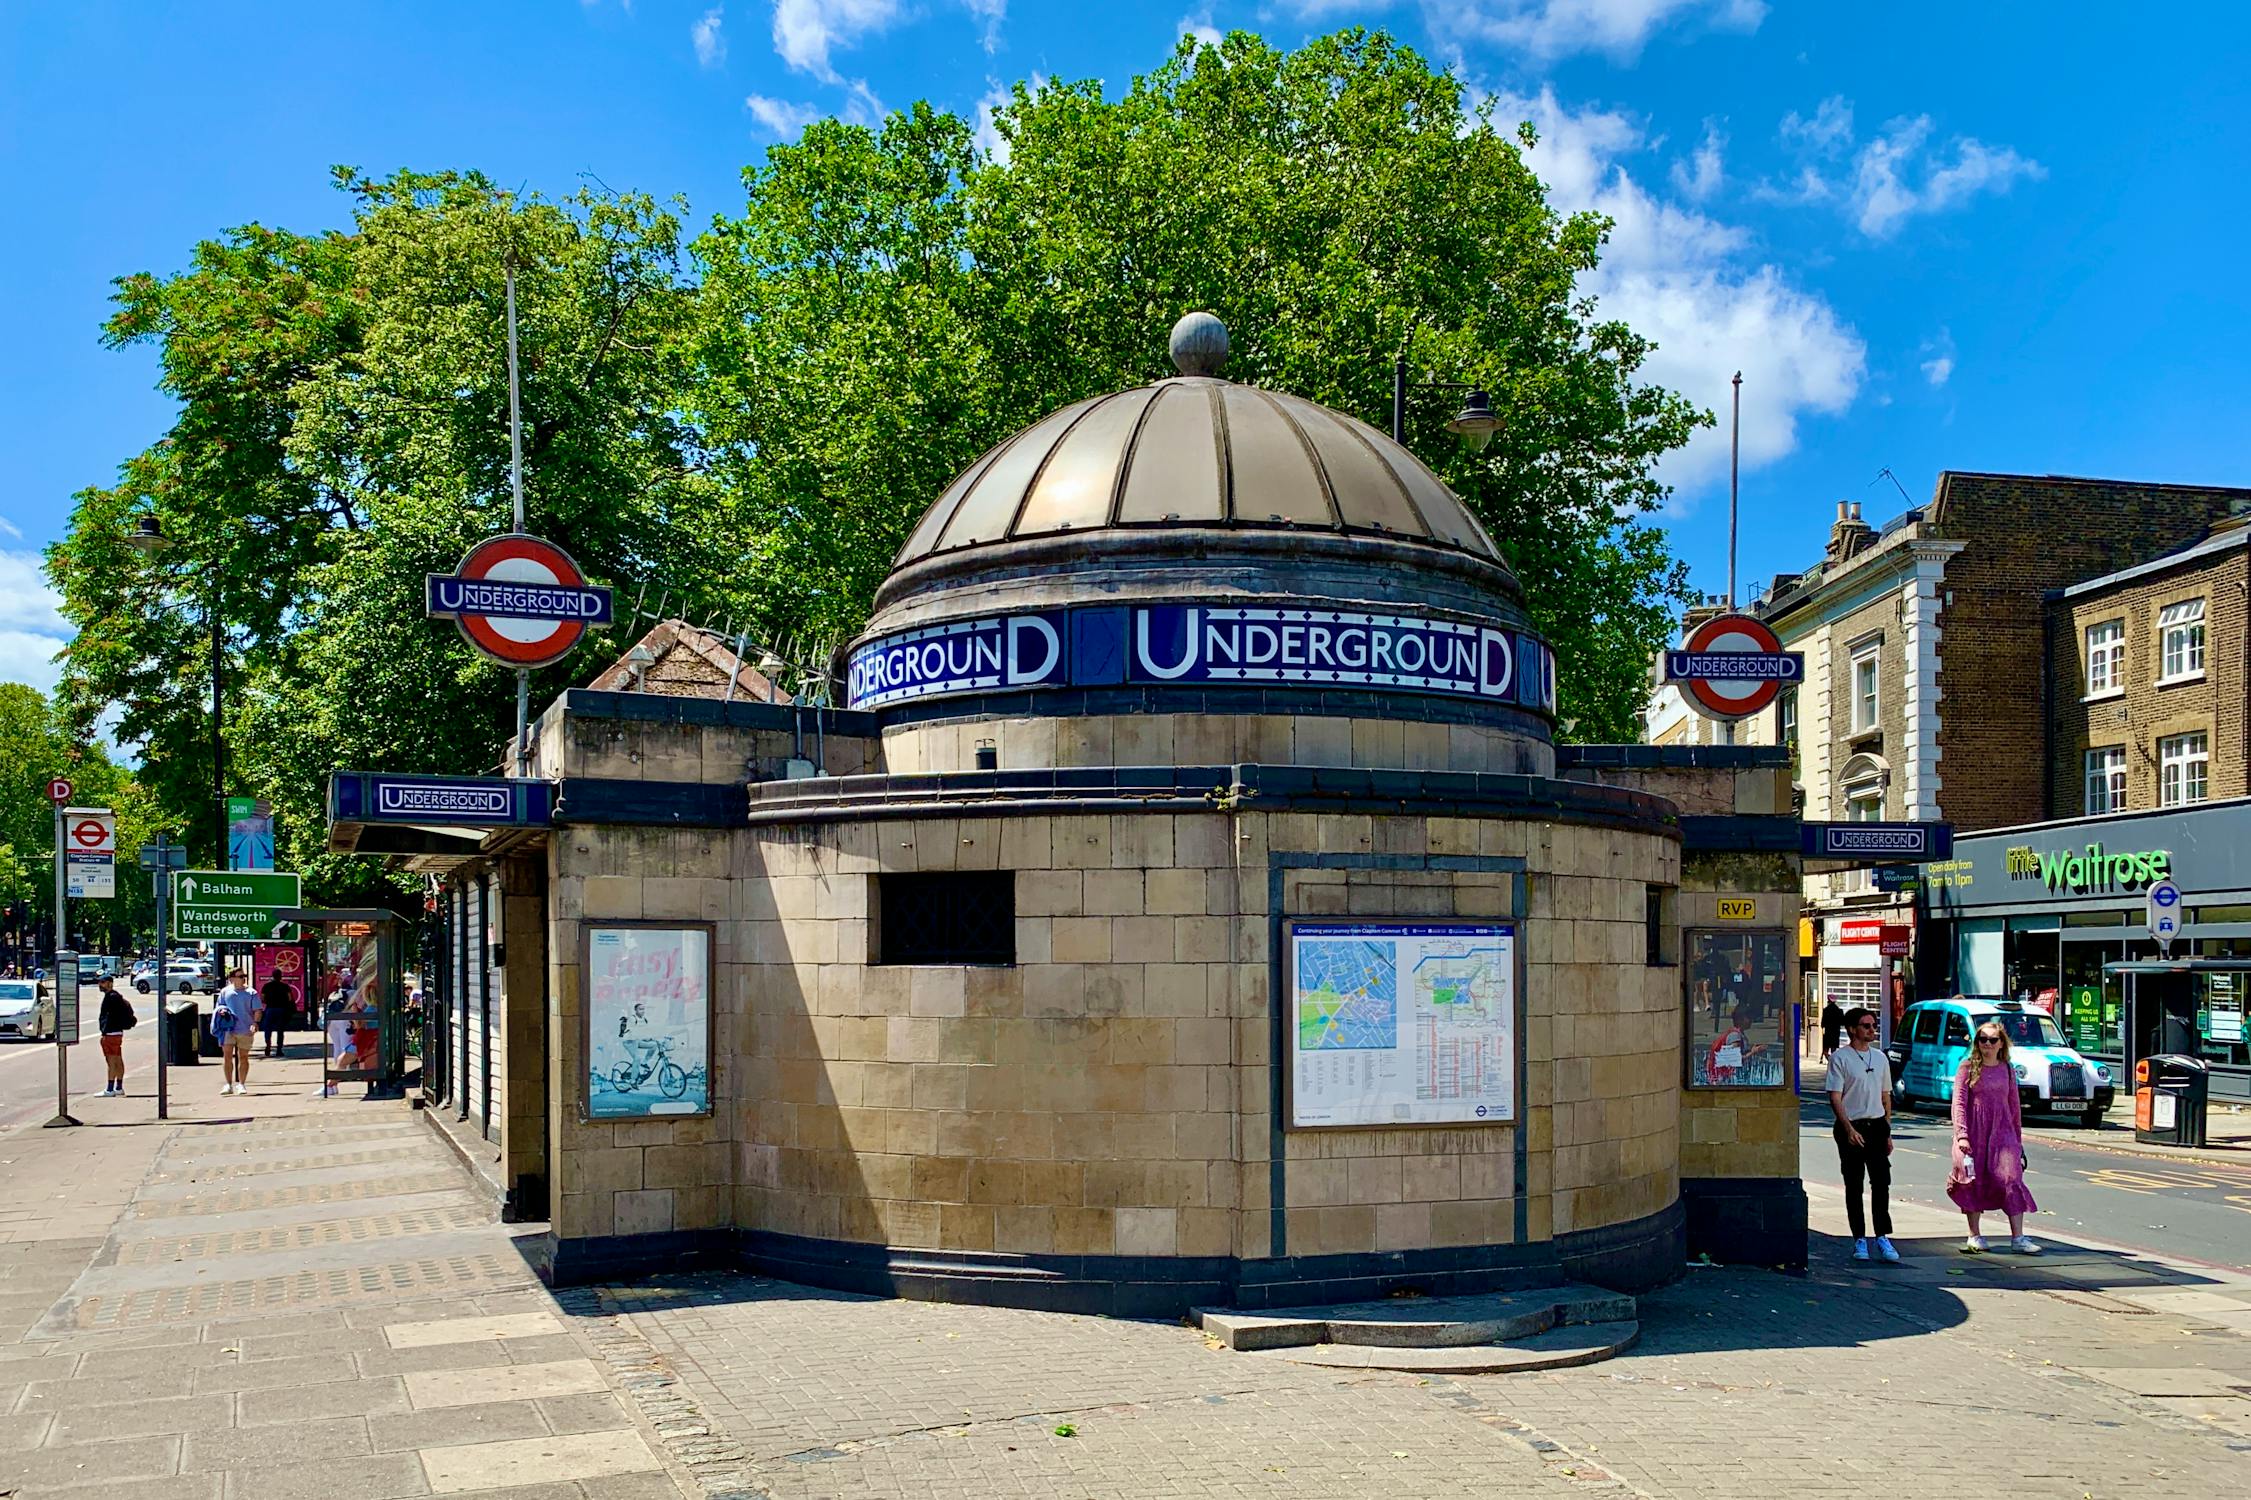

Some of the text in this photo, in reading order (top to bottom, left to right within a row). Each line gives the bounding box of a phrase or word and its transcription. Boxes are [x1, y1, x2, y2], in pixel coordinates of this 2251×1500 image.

[440, 583, 602, 617] UNDERGROUND
[1138, 608, 1513, 697] UNDERGROUND
[1673, 656, 1797, 677] UNDERGROUND
[54, 782, 70, 799] D
[385, 788, 505, 811] UNDERGROUND
[231, 805, 248, 814] SWIM
[1832, 832, 1921, 849] UNDERGROUND
[1928, 860, 1973, 874] Open daily from
[2040, 842, 2171, 889] Waitrose
[1884, 874, 1915, 882] Waitrose
[1928, 875, 1944, 888] 7am
[1944, 876, 1952, 887] to
[202, 882, 253, 895] Balham
[1721, 902, 1753, 915] RVP
[182, 909, 267, 922] Wandsworth
[182, 923, 250, 935] Battersea
[1842, 927, 1861, 938] FLIGHT
